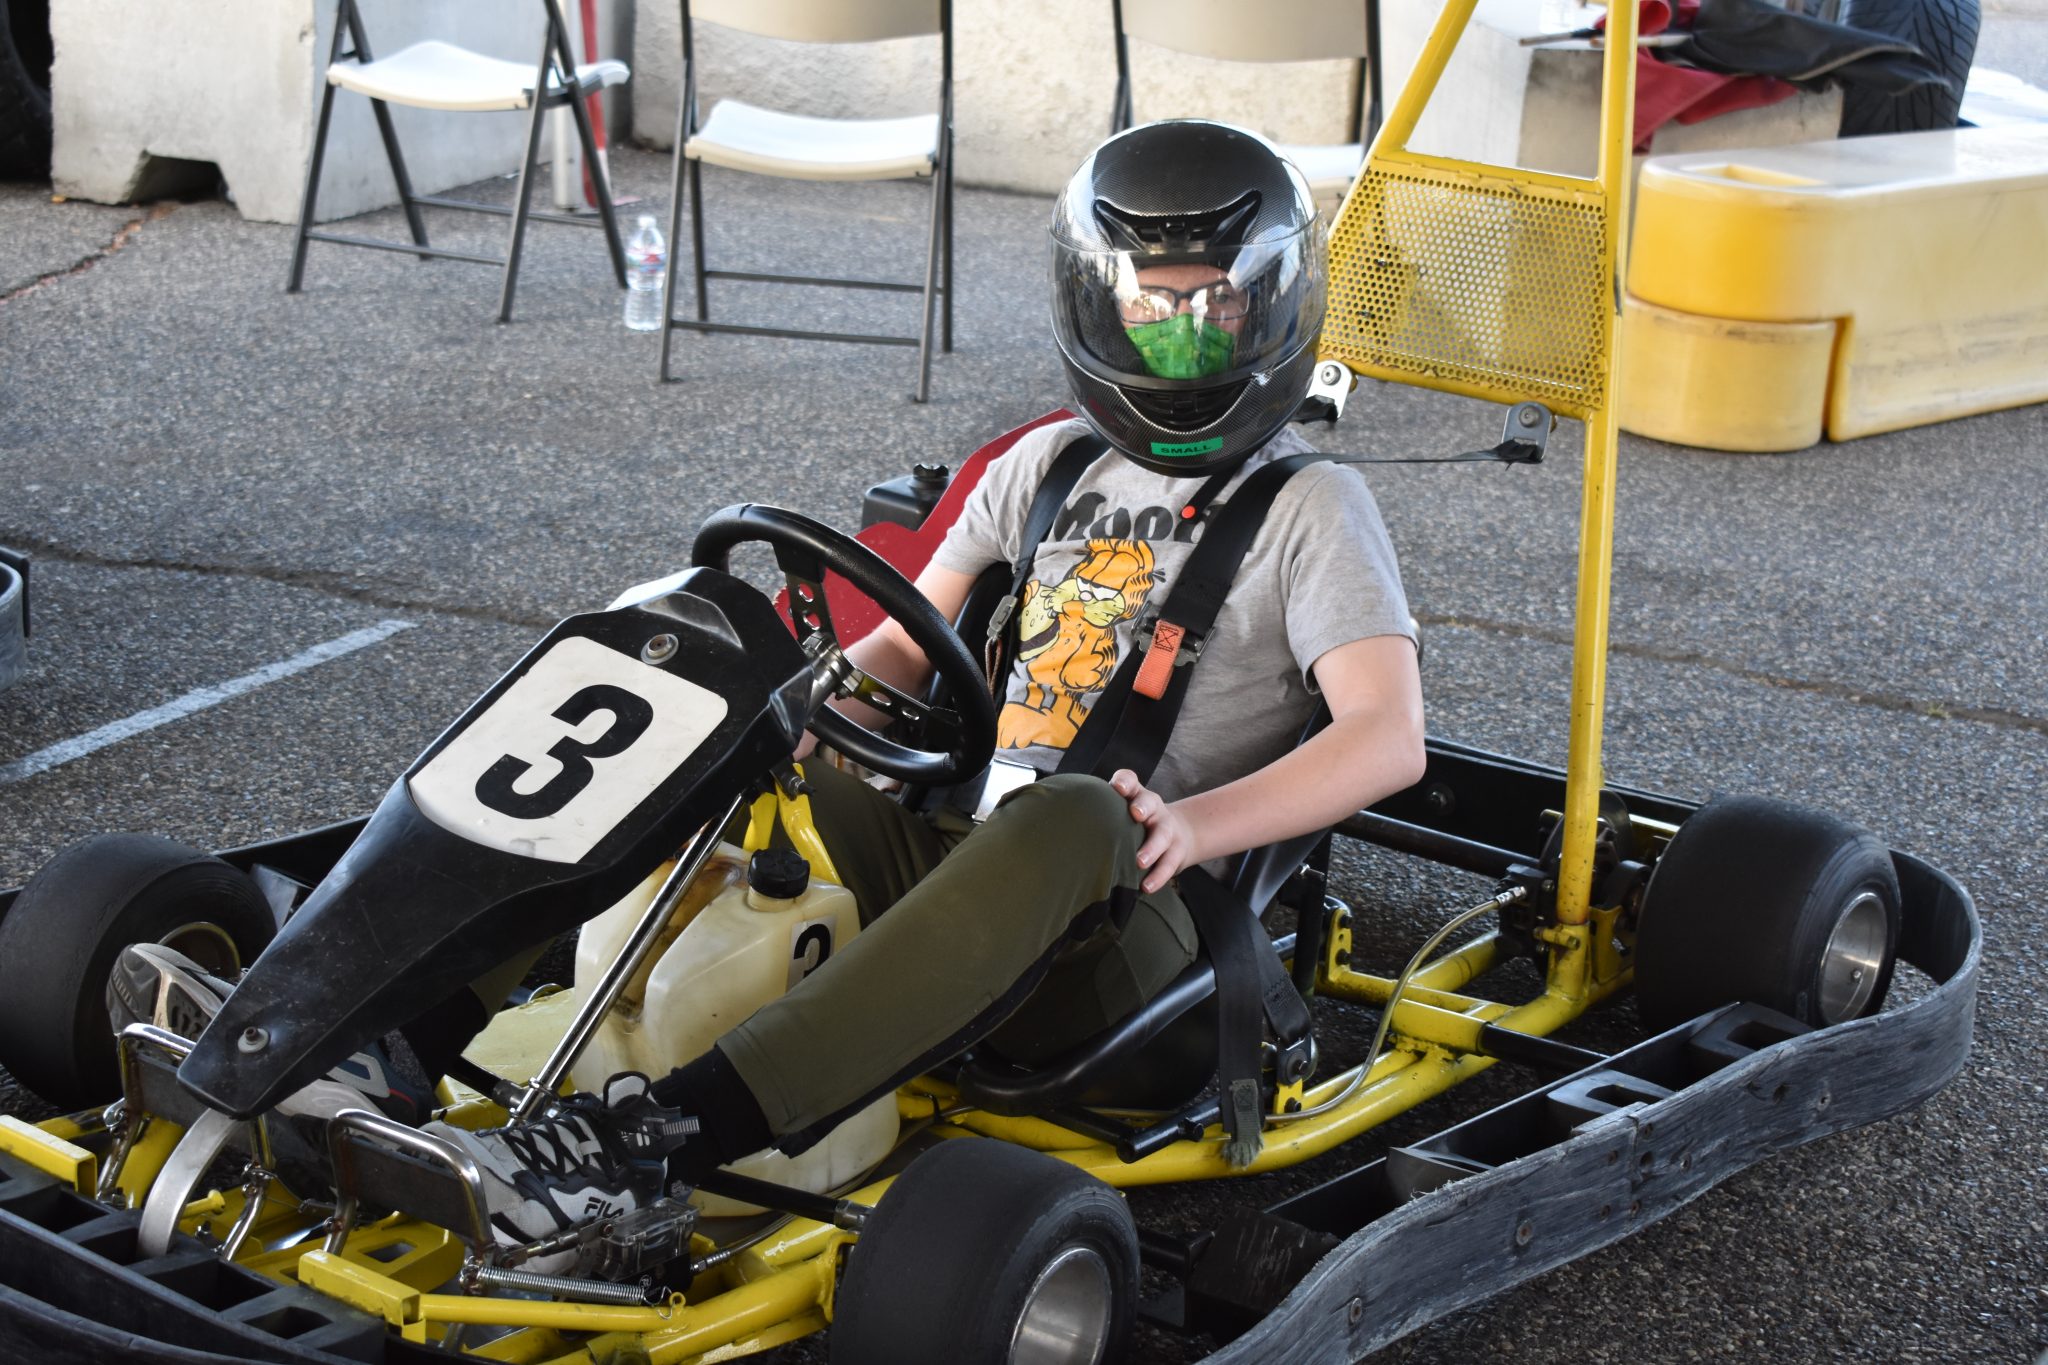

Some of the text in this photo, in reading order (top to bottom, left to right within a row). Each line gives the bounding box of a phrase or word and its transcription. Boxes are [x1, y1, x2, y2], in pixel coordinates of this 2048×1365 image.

[1161, 444, 1213, 454] SMALL
[475, 684, 654, 820] 3
[584, 1196, 625, 1219] FILA
